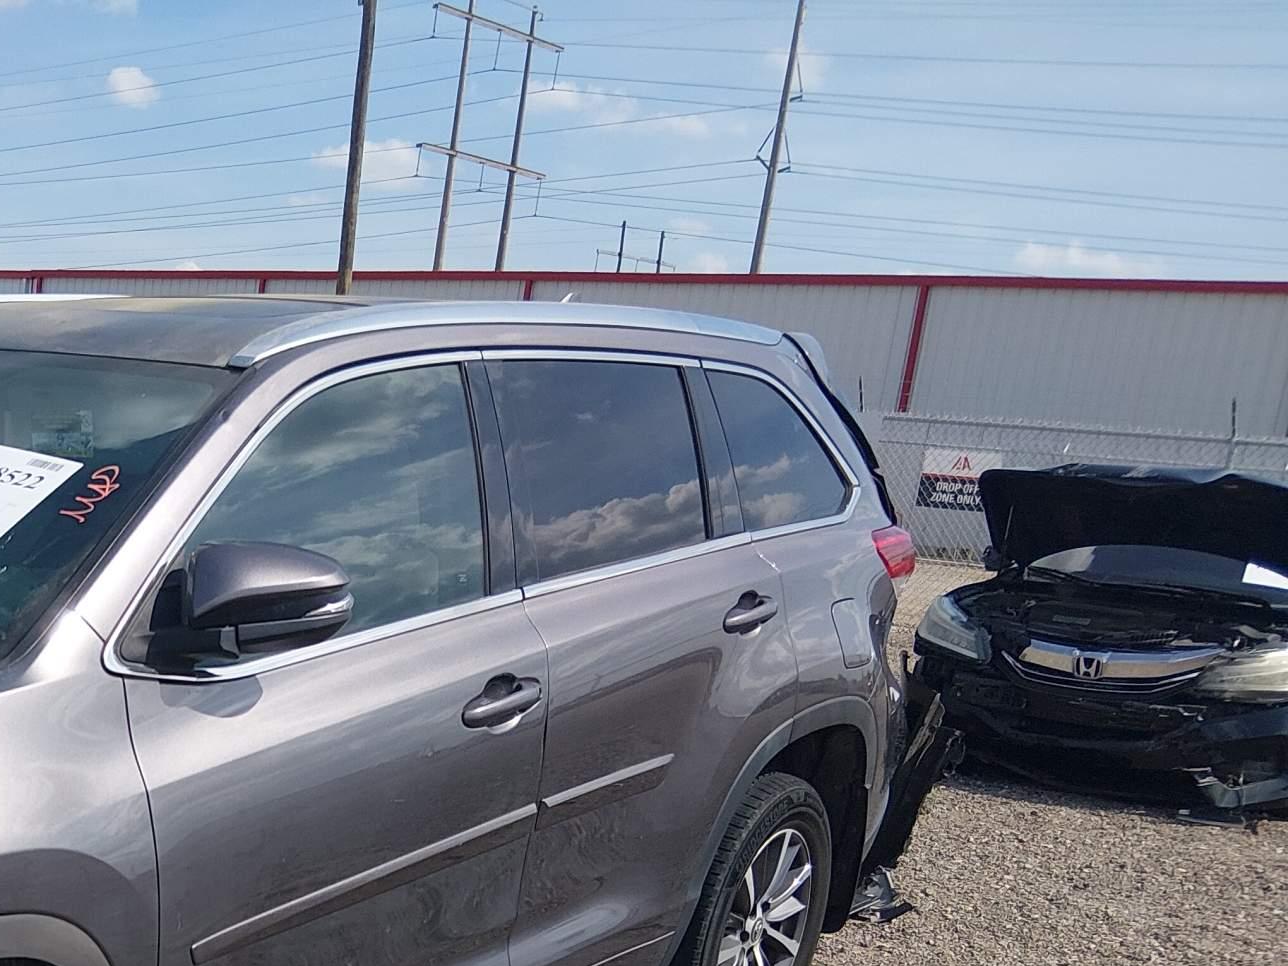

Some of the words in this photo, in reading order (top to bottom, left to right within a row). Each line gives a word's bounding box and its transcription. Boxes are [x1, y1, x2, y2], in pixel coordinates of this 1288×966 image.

[935, 481, 962, 492] DROP
[963, 483, 980, 494] OFF
[930, 491, 955, 503] ZONE
[956, 493, 981, 506] ONLY
